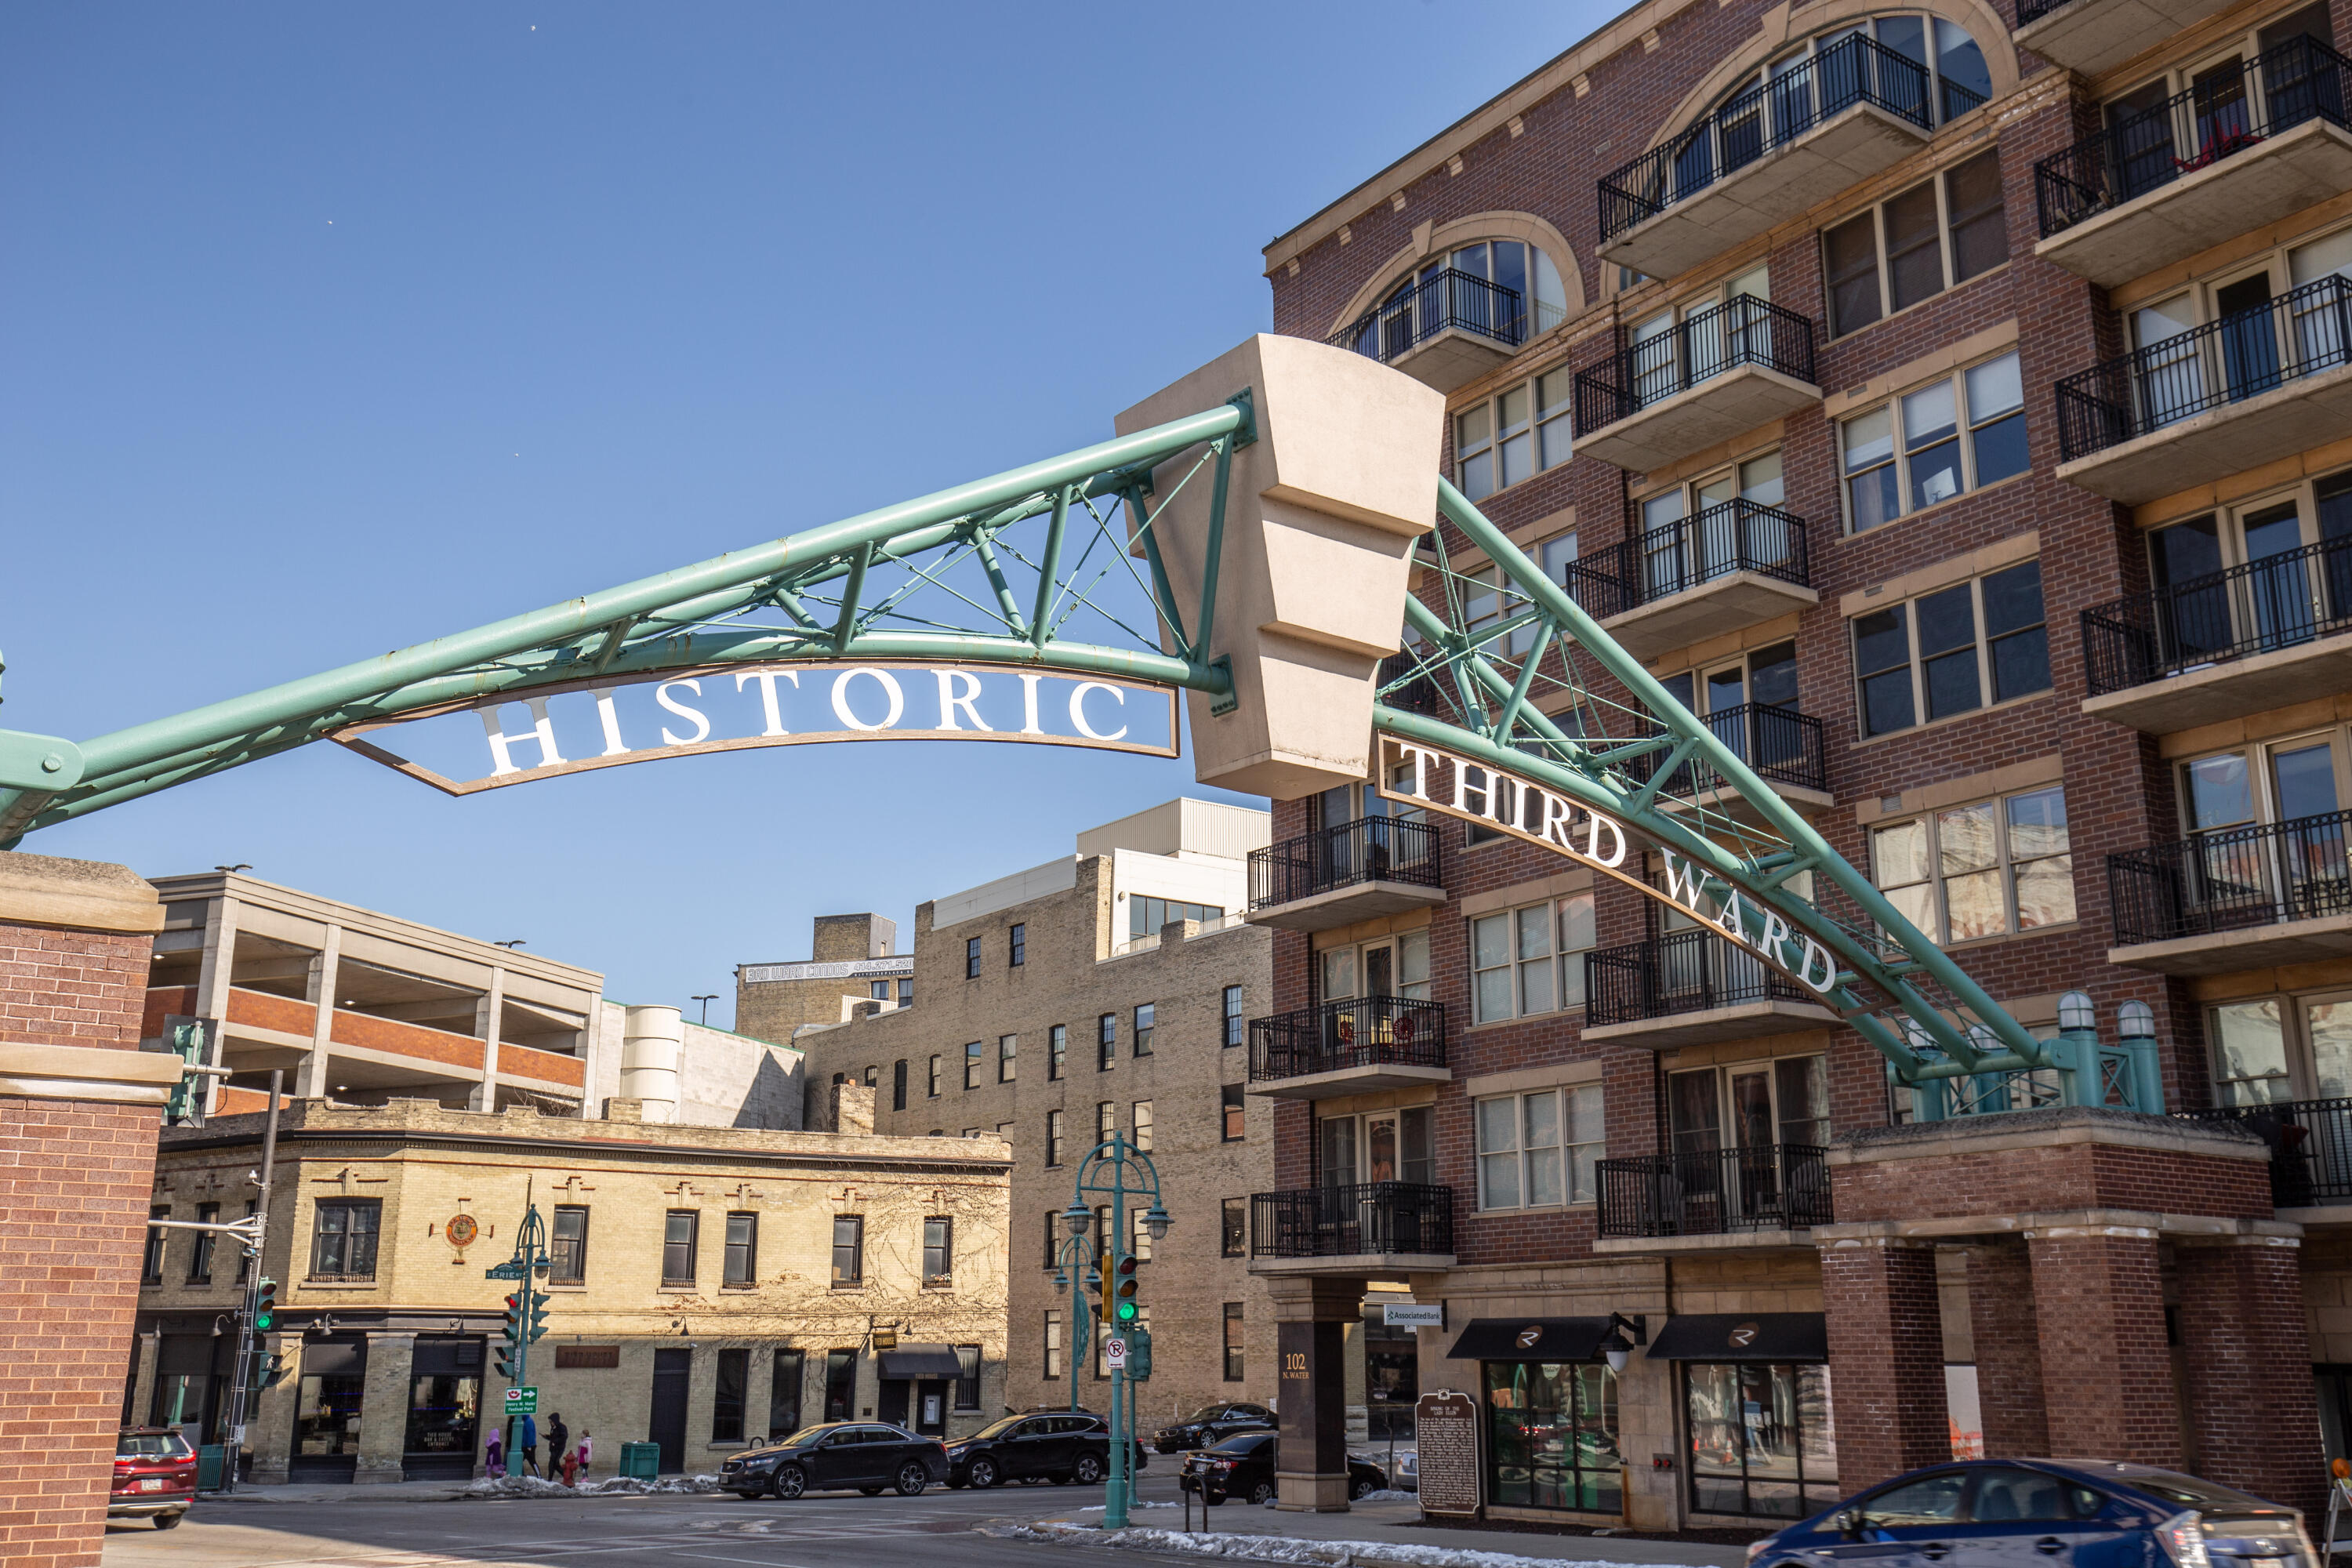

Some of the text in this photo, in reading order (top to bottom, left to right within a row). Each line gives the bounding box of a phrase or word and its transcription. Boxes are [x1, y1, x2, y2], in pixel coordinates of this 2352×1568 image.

[472, 667, 1129, 778] HISTORIC
[1400, 742, 1837, 994] THIRD WARD
[747, 964, 848, 981] 3RD WARD CONDOS
[854, 959, 913, 971] 414.271.520
[1286, 1353, 1305, 1370] 102
